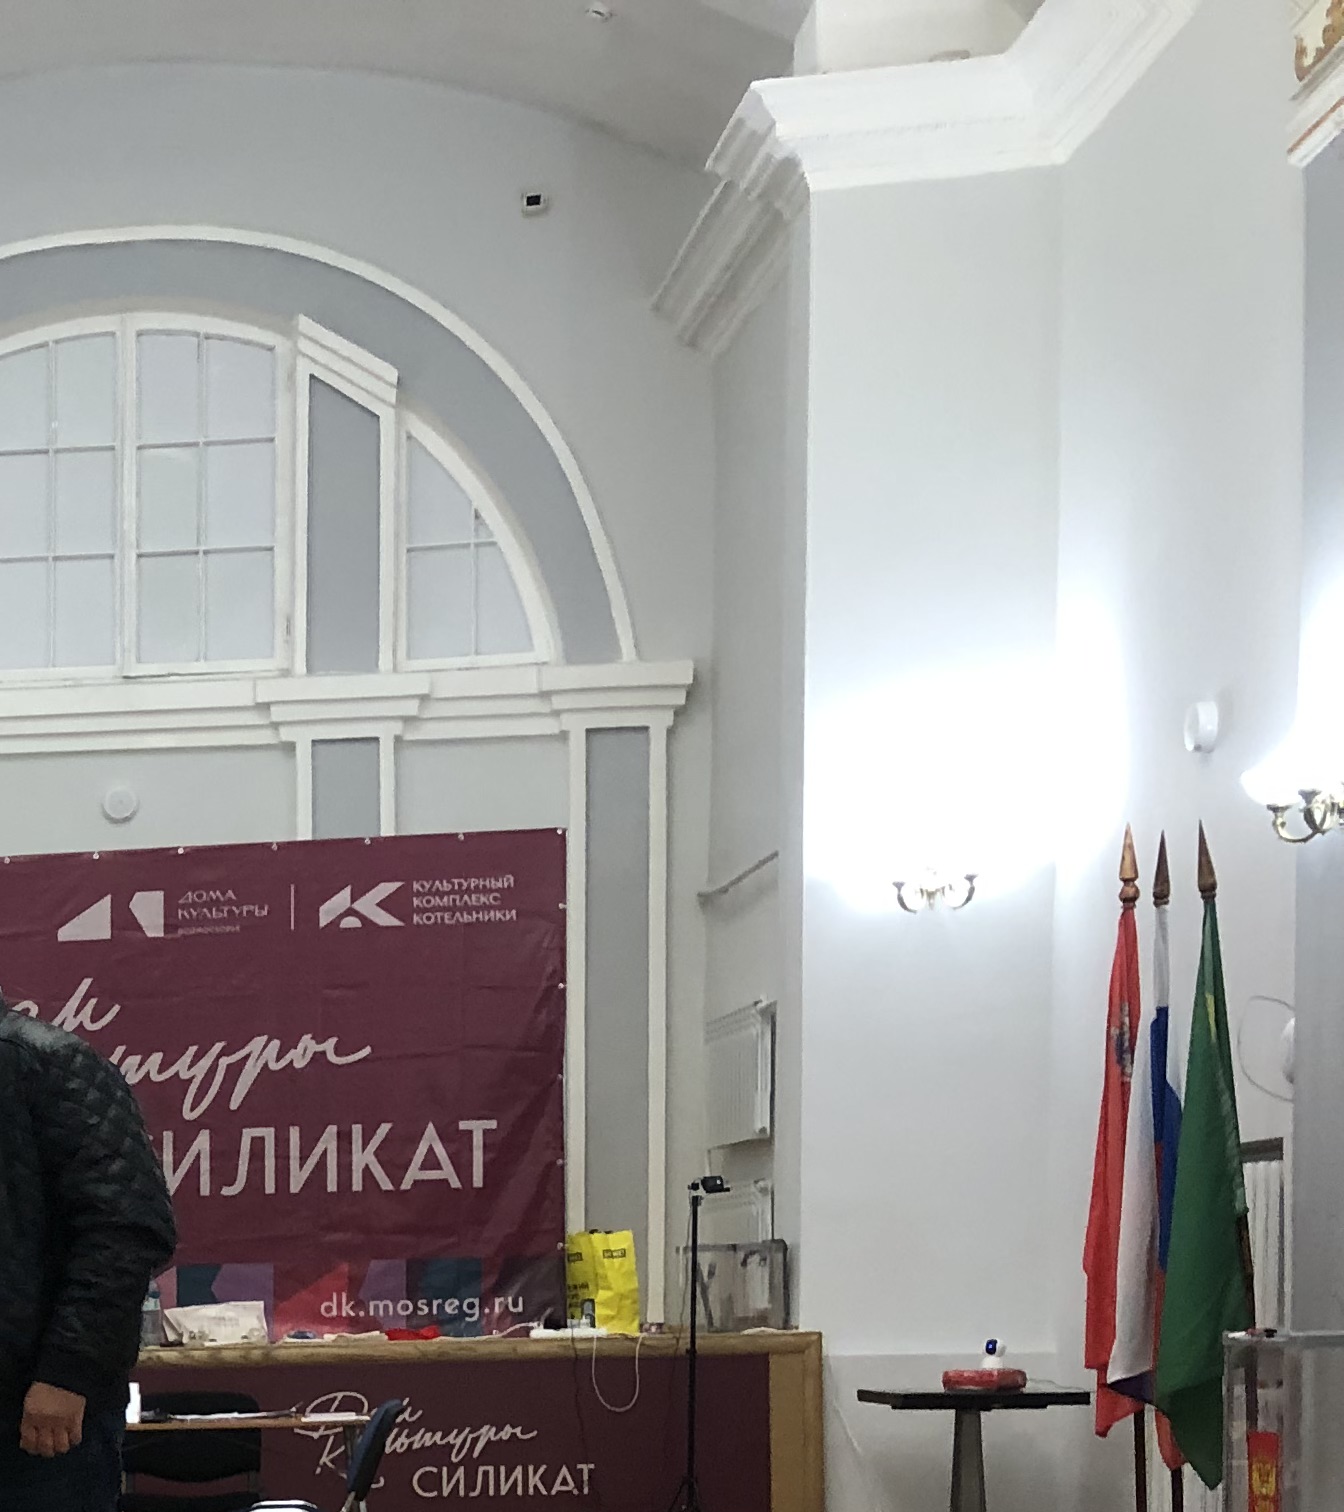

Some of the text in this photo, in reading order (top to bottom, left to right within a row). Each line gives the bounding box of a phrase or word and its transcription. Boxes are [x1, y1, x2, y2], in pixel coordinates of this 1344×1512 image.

[412, 874, 515, 893] КУЛЬТУРНЫЙ
[178, 889, 238, 904] ДОМА
[412, 892, 502, 908] КОМПЛЕКС
[177, 904, 269, 920] КУЛЬТУРЫ
[413, 909, 518, 926] КОТЕЛЬНИКИ
[149, 1119, 499, 1197] ИЛИКАТ
[319, 1291, 525, 1323] dk.mosreg.ru
[412, 1462, 596, 1498] СИЛИКАТ
